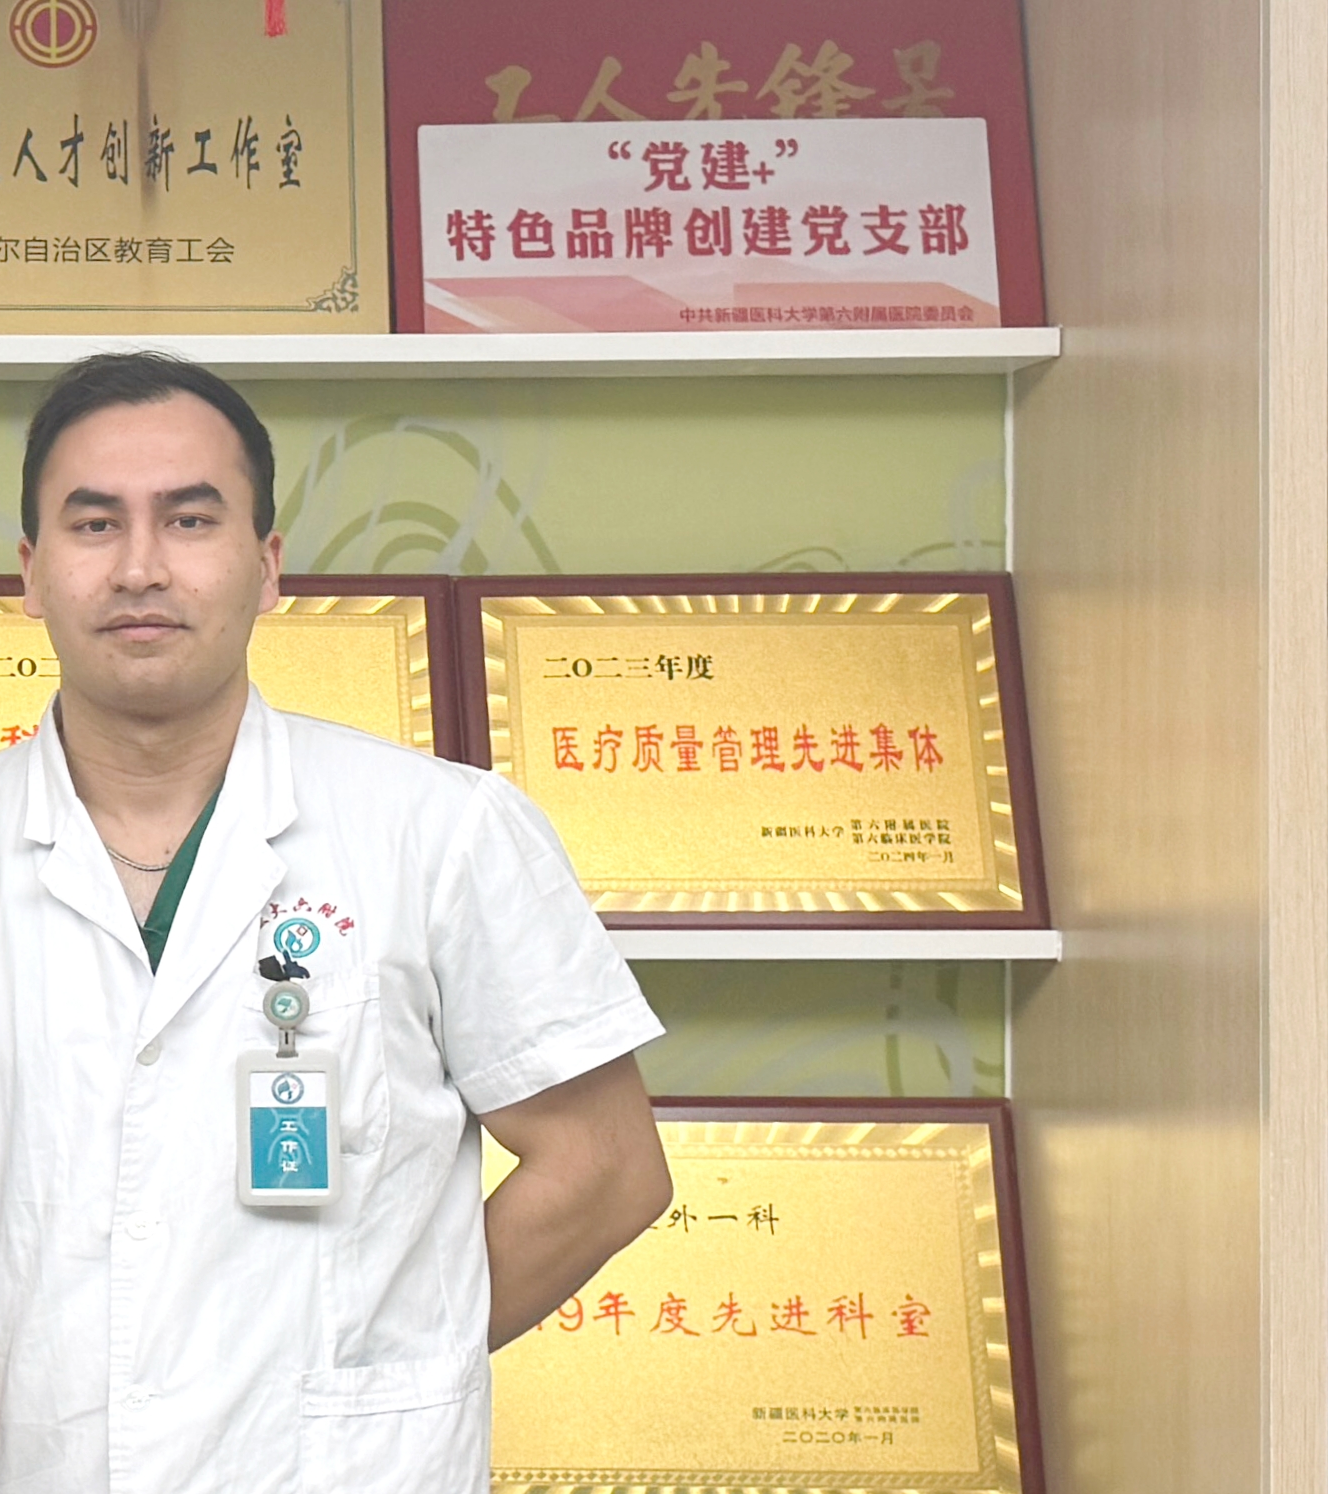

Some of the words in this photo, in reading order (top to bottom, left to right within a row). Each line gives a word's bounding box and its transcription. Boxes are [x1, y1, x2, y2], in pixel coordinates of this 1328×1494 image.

[446, 203, 970, 261] 特色品牌创建党支部
[679, 305, 974, 323] 中共新疆医科大学第六附属医院委员会
[552, 721, 945, 774] 医疗质量管理先进集体
[649, 1203, 780, 1236] 外一科
[535, 1291, 932, 1339] 9年度先进科室
